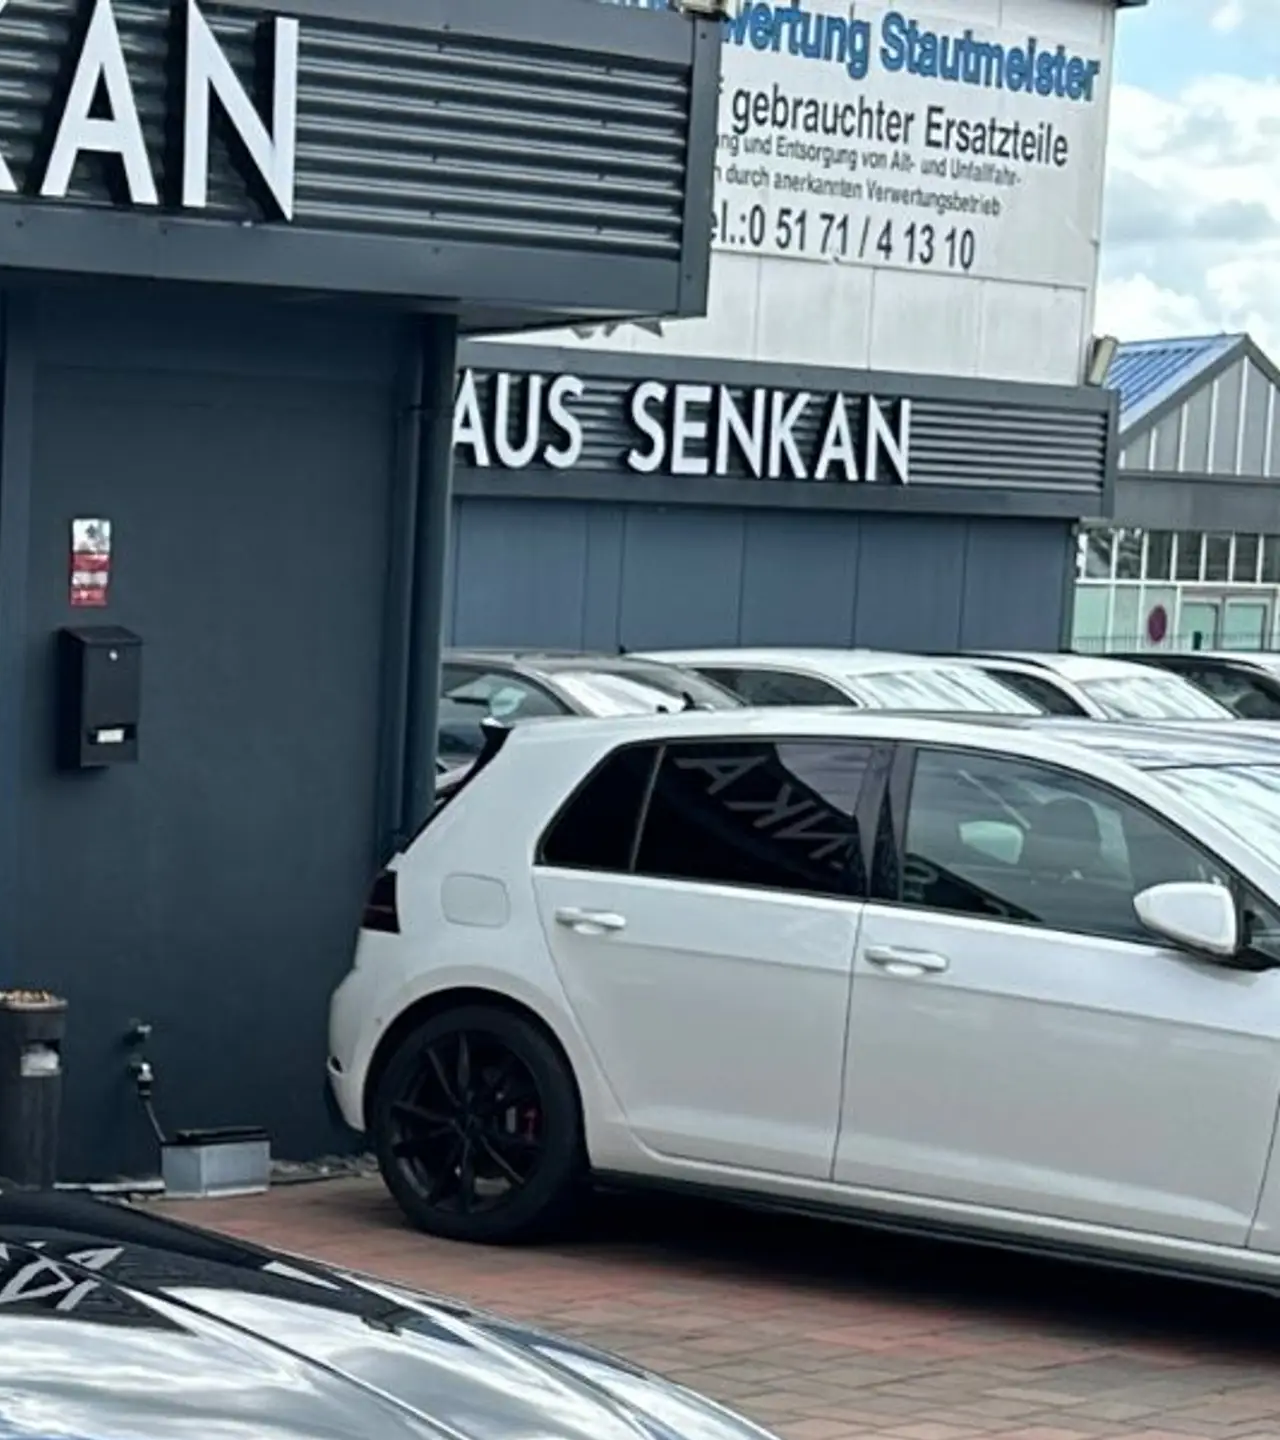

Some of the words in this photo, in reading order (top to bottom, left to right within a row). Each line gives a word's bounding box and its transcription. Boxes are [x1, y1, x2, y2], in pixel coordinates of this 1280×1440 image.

[880, 11, 1101, 102] Stautmeister
[731, 83, 915, 144] gebrauchter
[924, 106, 1069, 167] Ersatzteile
[743, 134, 772, 156] und
[775, 136, 859, 172] Entsorgung
[861, 151, 888, 169] von
[920, 157, 948, 178] und
[725, 162, 770, 188] durch
[773, 171, 862, 198] anerkannten
[866, 179, 1001, 216] Verwertungsbetrieb
[775, 207, 807, 251] 51
[818, 213, 849, 255] 71
[876, 218, 893, 261] 4
[903, 221, 935, 265] 13
[944, 227, 975, 270] 10
[627, 381, 912, 485] SENKAN
